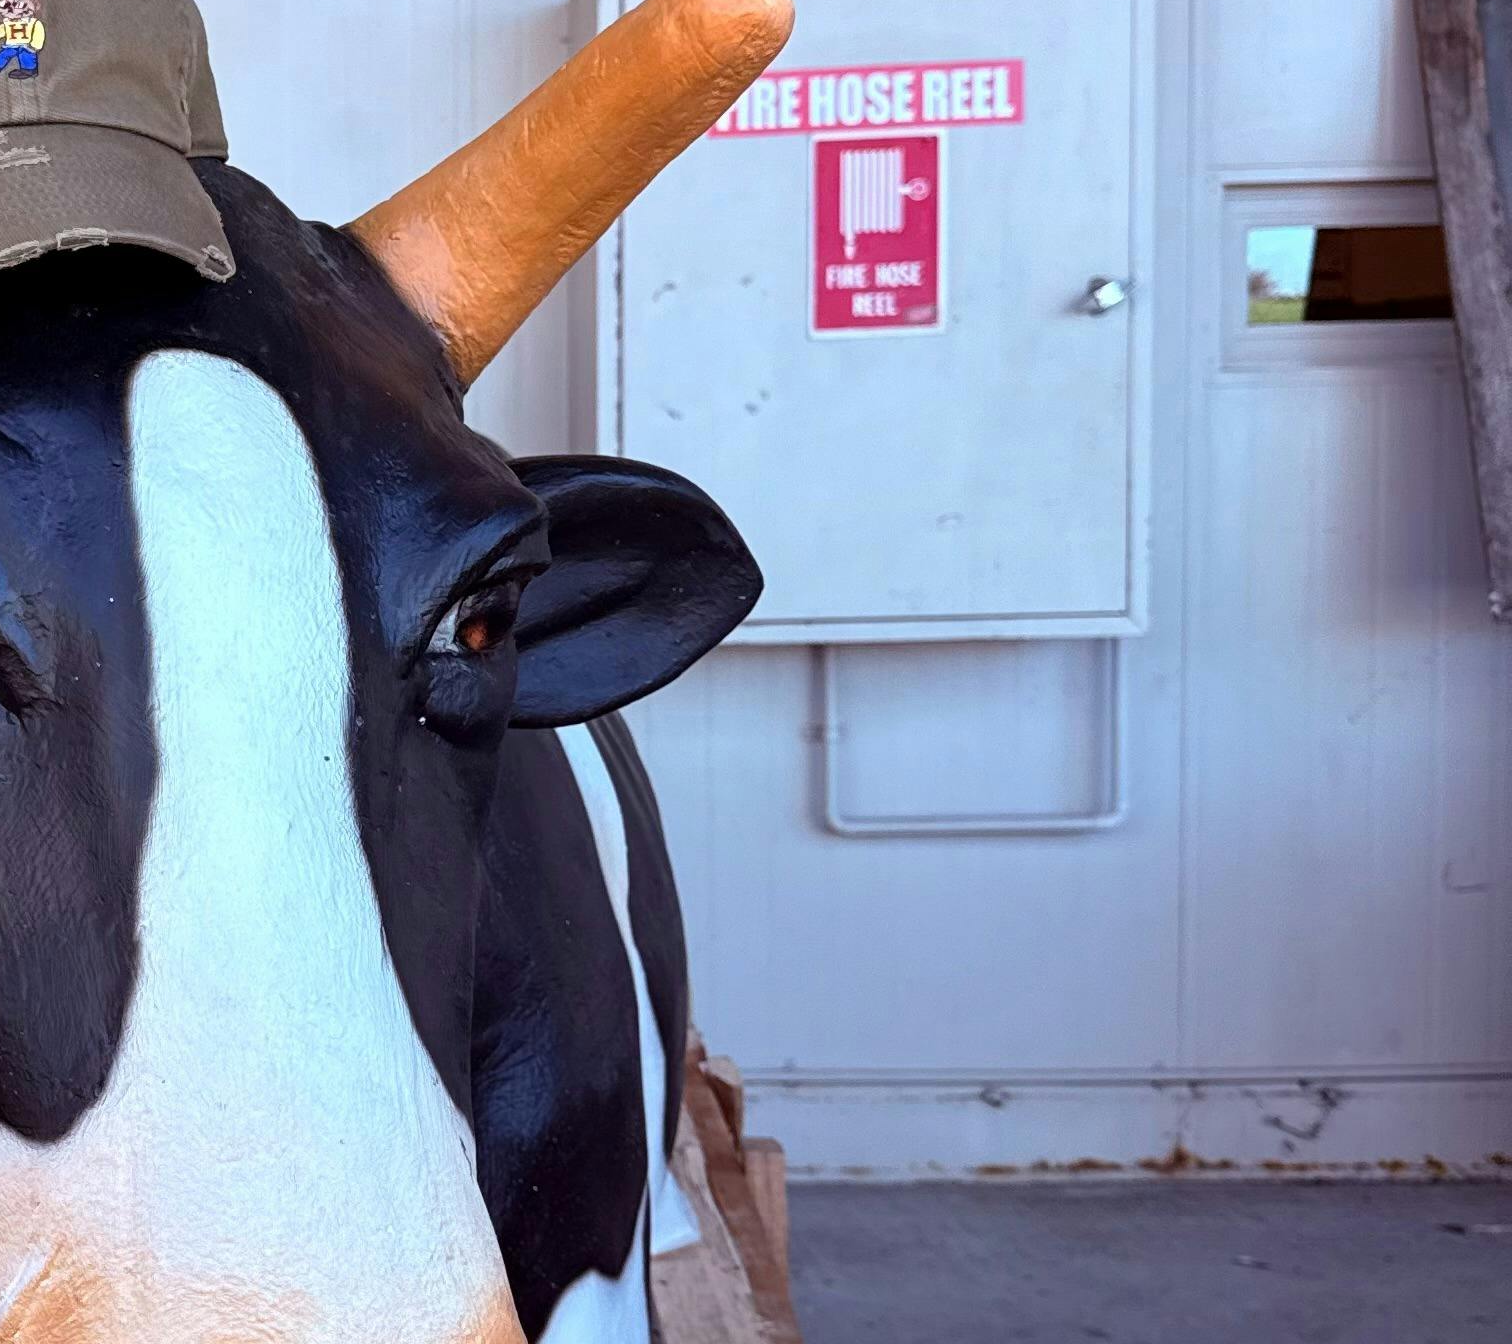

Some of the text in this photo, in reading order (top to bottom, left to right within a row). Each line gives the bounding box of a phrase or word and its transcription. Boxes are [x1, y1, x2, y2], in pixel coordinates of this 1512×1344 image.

[10, 23, 29, 40] H
[714, 67, 1015, 131] IRE HOSE REEL
[825, 261, 925, 289] FIRE HOSE
[851, 292, 898, 317] REEL
